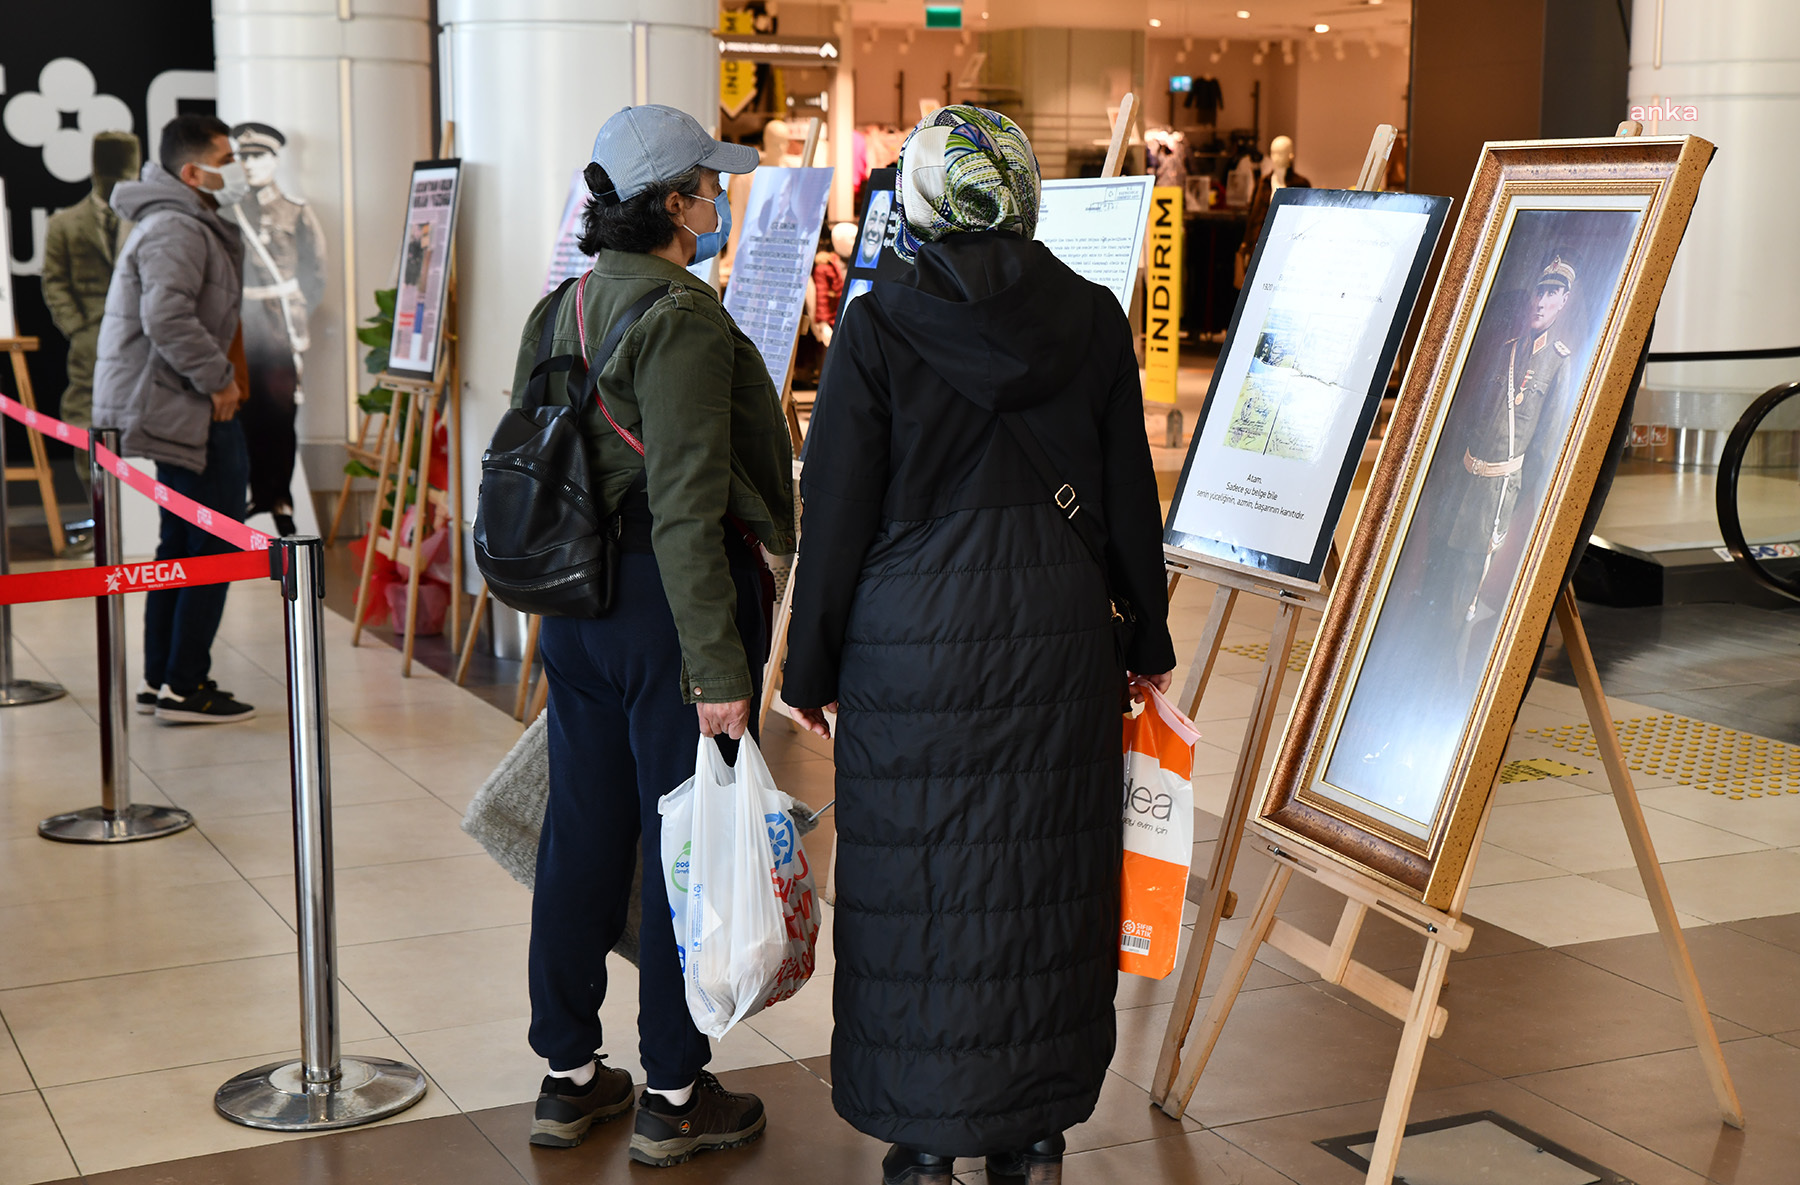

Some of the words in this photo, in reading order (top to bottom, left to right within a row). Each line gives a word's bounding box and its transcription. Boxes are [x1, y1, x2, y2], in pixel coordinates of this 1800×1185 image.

[1196, 489, 1209, 498] senin
[1225, 481, 1244, 493] Sadece
[1244, 487, 1252, 496] şu
[1251, 487, 1267, 500] belge
[1267, 490, 1278, 501] bile
[123, 561, 187, 585] VEGA
[1122, 778, 1173, 822] dea
[1136, 820, 1154, 831] evim
[1135, 929, 1152, 938] ATIK
